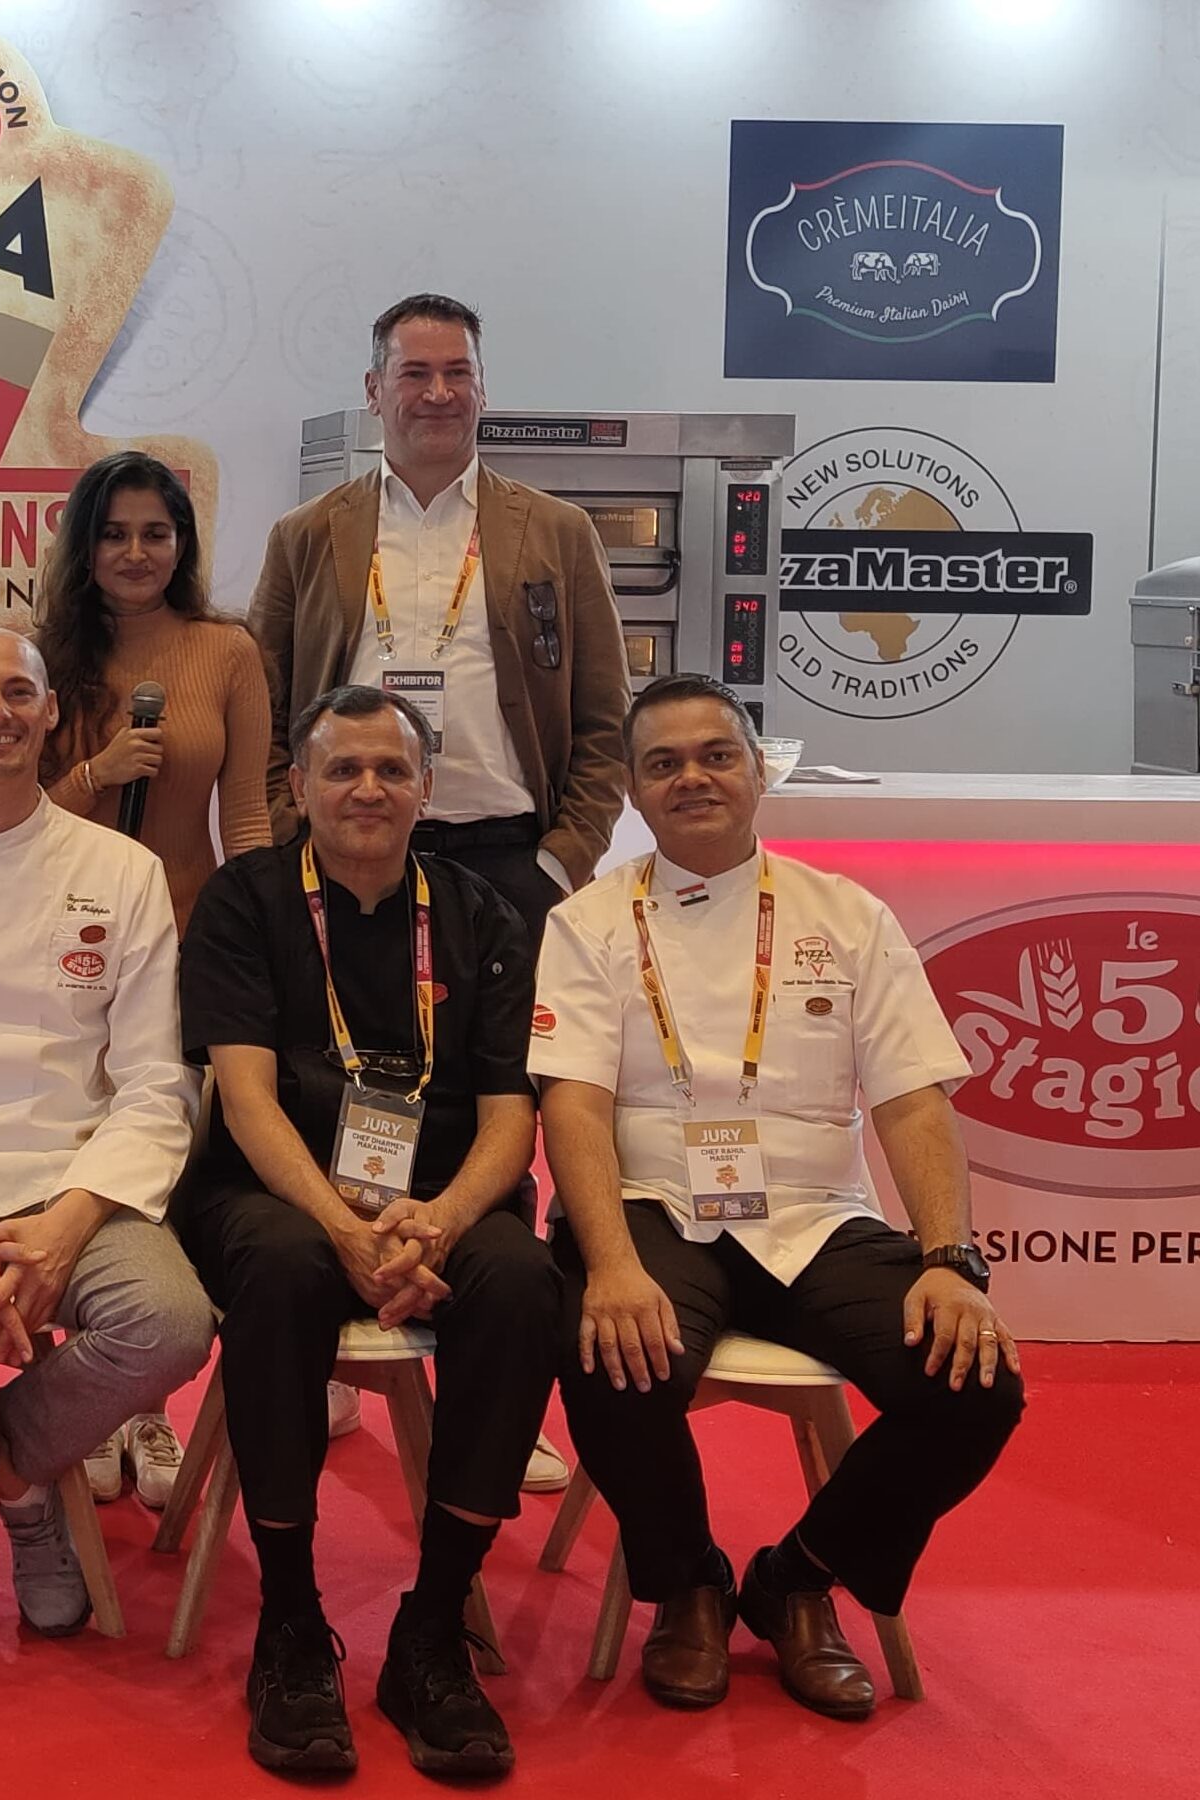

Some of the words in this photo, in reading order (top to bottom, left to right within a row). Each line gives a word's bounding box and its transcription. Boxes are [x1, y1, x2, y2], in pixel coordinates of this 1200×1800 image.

[797, 194, 990, 257] CRÈMEITALIA
[815, 285, 878, 320] Premium
[879, 307, 929, 323] Italian
[932, 290, 970, 317] Dairy
[482, 424, 583, 439] PizzaMaster
[786, 459, 841, 510] NEW
[845, 448, 980, 510] SOLUTIONS
[737, 491, 762, 502] 420
[734, 601, 758, 611] 340
[779, 634, 823, 678] OLD
[830, 637, 980, 700] TRADITIONS
[385, 675, 442, 687] EXHIBITOR
[1091, 959, 1184, 1045] 5
[953, 1011, 1200, 1140] Stagi
[361, 1116, 402, 1137] JURY
[700, 1128, 742, 1143] JURY
[352, 1132, 369, 1143] CHEF
[371, 1136, 406, 1152] DHARMEN
[700, 1148, 719, 1156] CHEF
[720, 1147, 746, 1155] RAHUL
